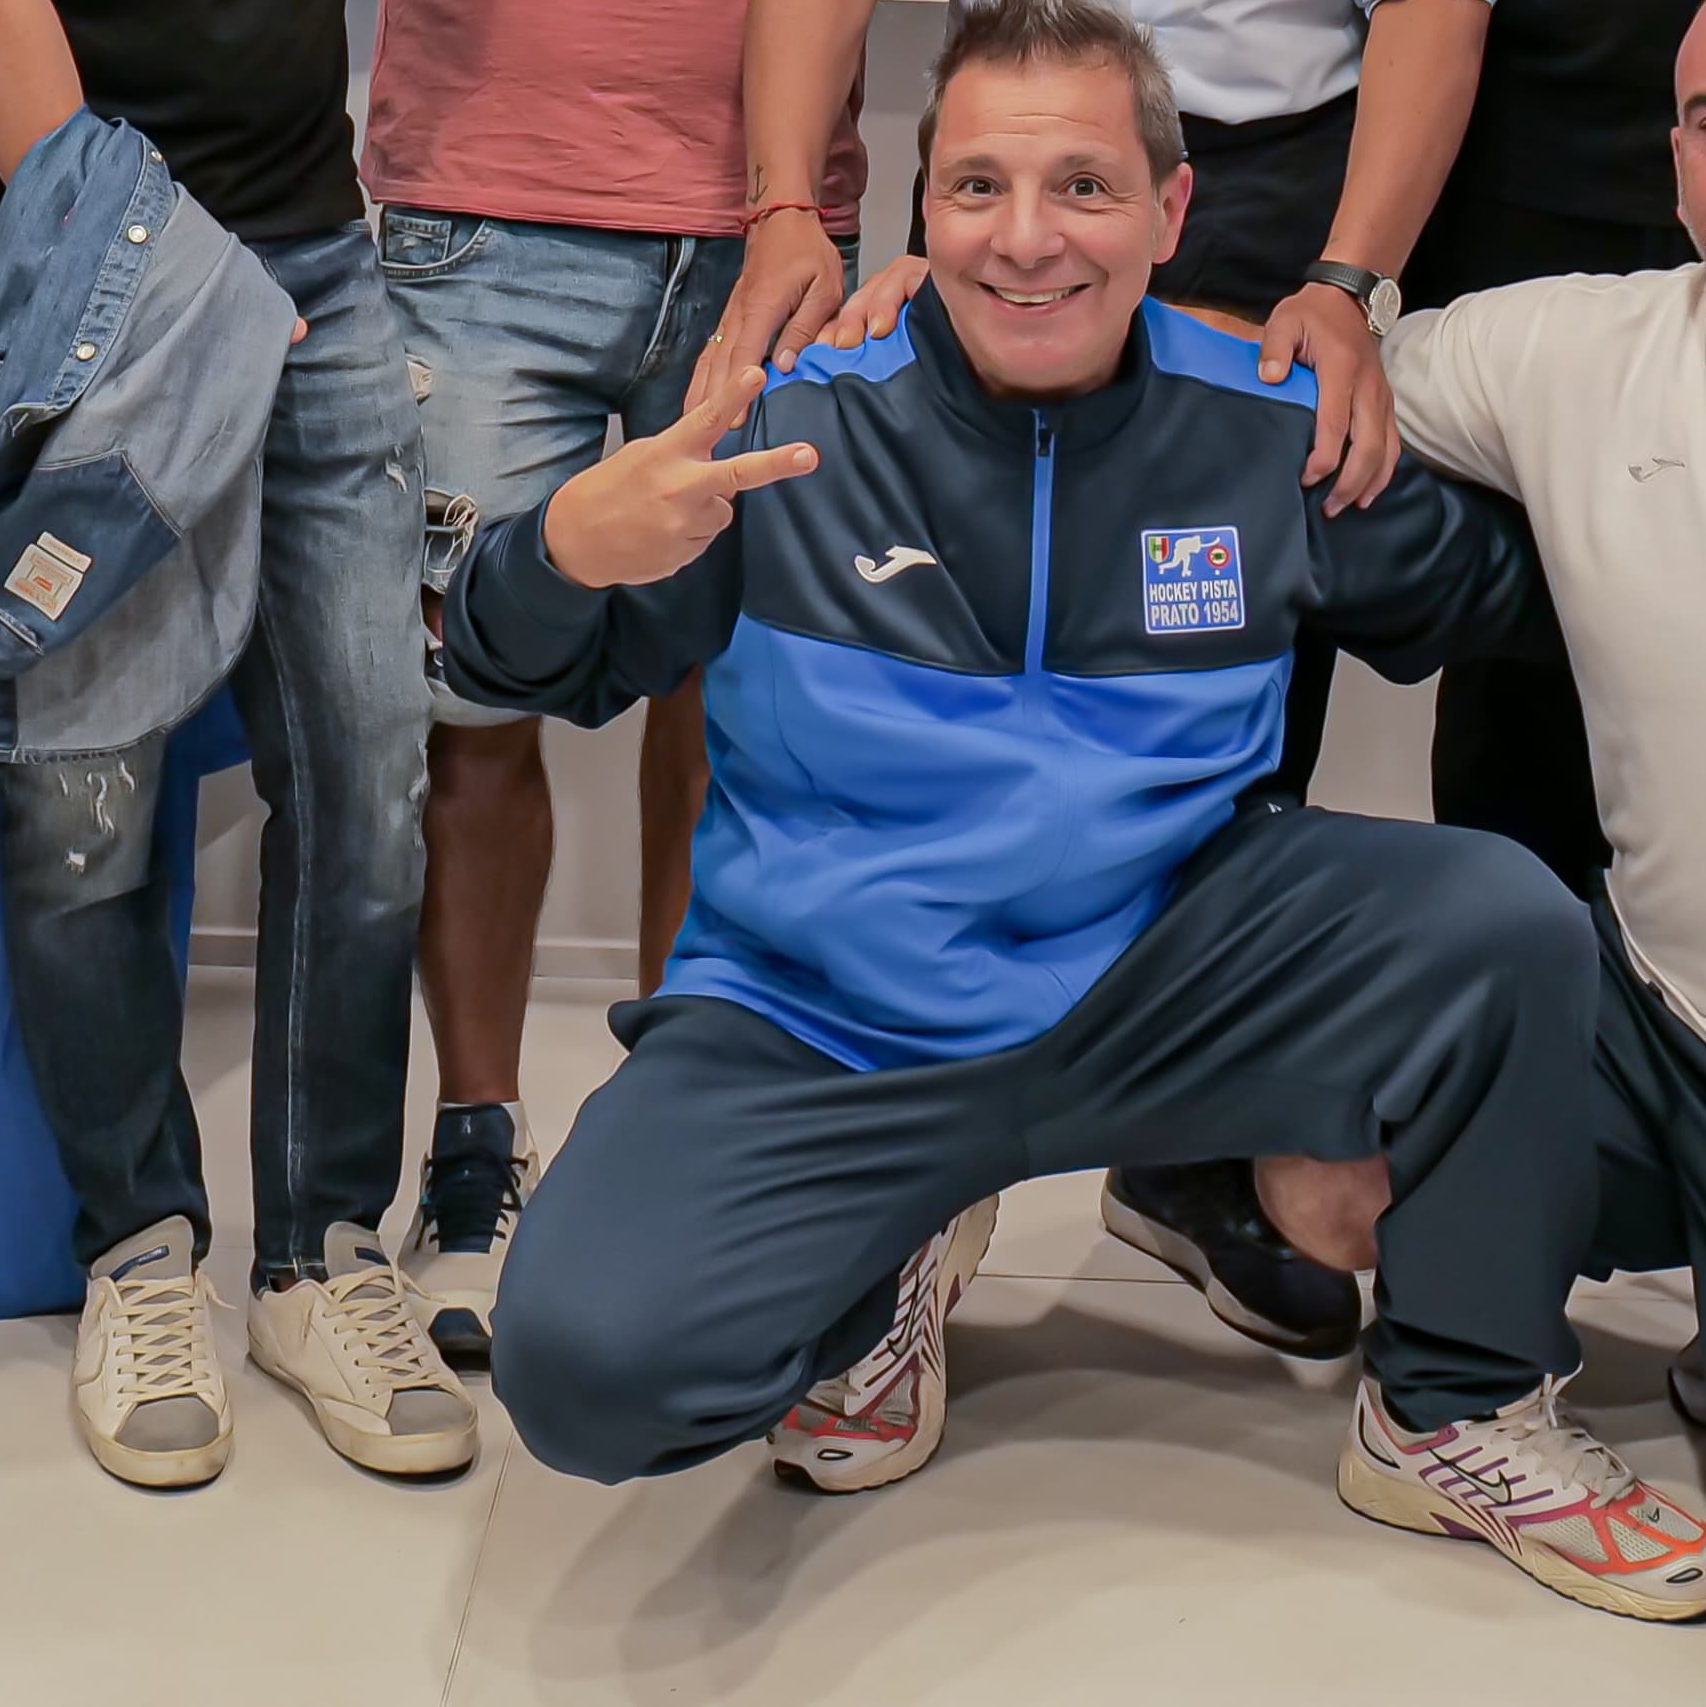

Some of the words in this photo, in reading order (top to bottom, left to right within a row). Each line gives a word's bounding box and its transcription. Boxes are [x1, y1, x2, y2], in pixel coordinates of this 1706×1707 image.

[1149, 581, 1198, 602] HOCKEY
[1201, 579, 1237, 599] PISTA
[1150, 604, 1200, 627] PRATO
[1204, 600, 1239, 624] 1954
